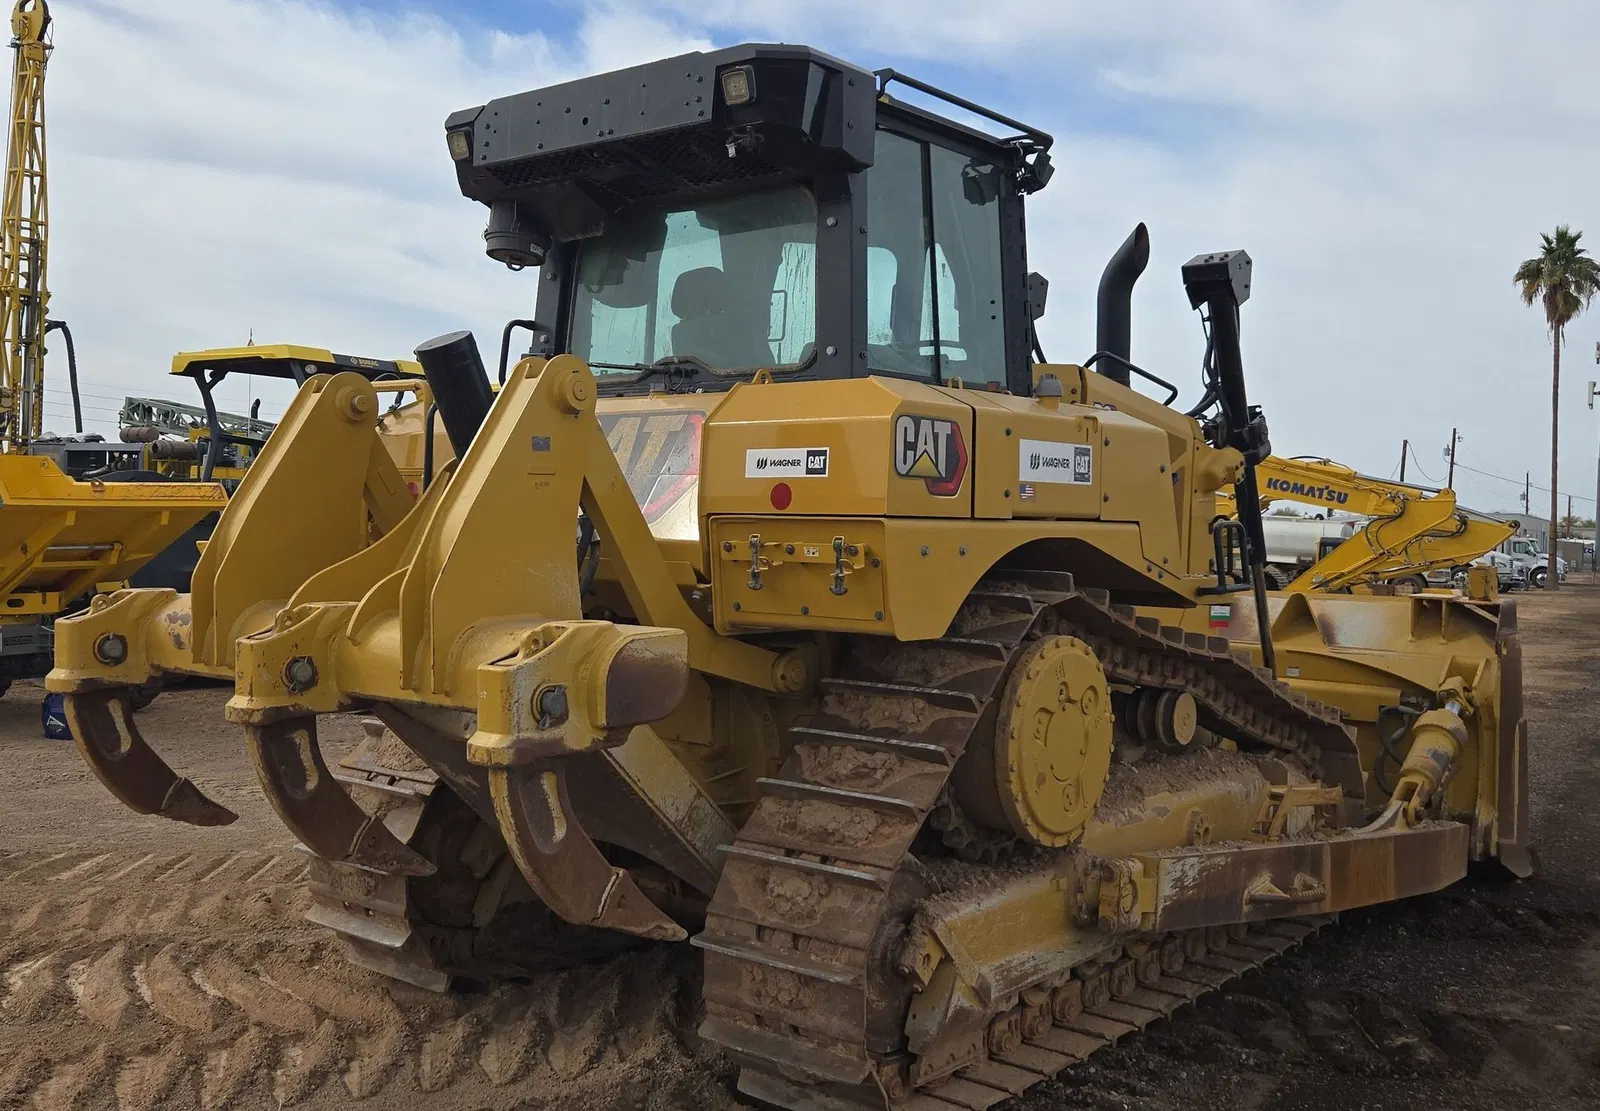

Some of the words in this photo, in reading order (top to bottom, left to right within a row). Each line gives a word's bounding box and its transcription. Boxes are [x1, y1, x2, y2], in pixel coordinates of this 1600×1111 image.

[606, 414, 688, 489] AT
[895, 415, 952, 478] CAT
[769, 458, 802, 467] WAGNER
[807, 455, 826, 469] CAT
[1042, 456, 1071, 469] WAGNER
[1075, 455, 1090, 474] CAT
[1266, 477, 1349, 504] KOMATSU
